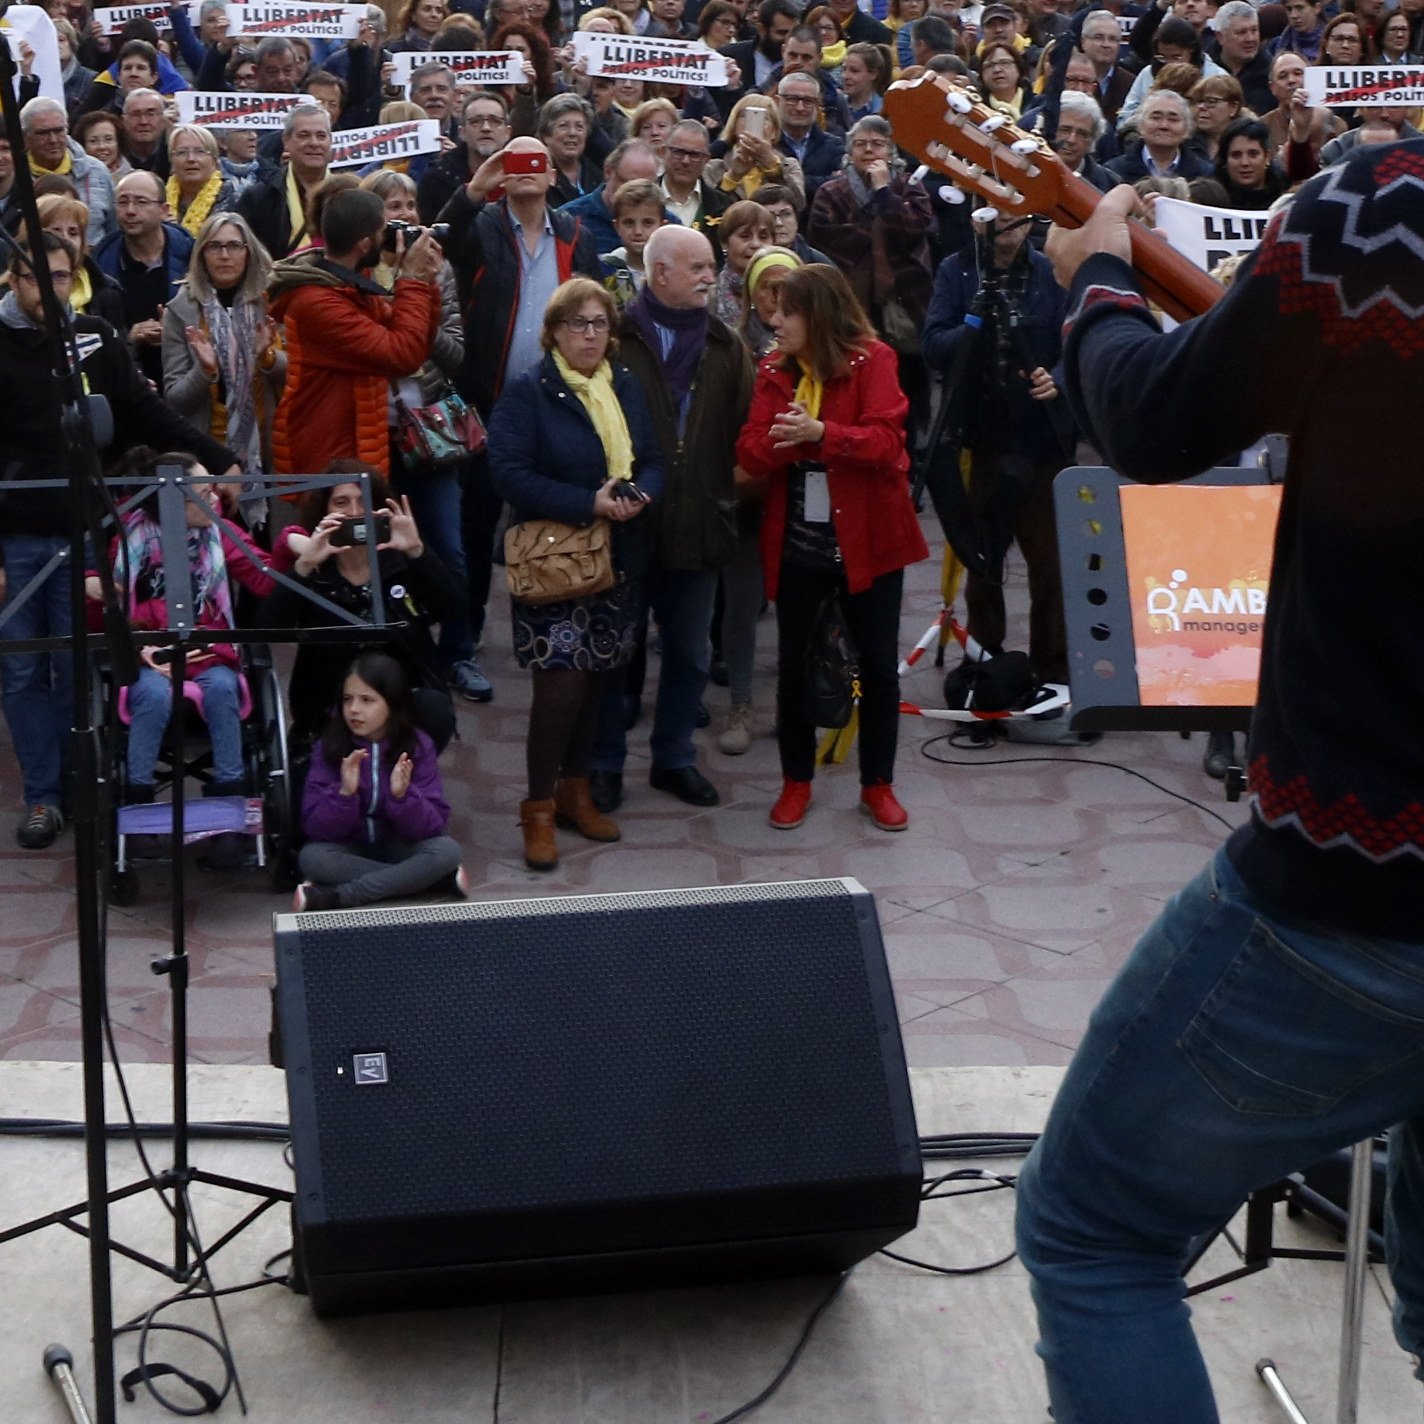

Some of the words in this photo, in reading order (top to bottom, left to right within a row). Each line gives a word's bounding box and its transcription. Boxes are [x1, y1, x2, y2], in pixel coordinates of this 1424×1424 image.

[243, 8, 344, 24] LLIBERTAT
[603, 45, 710, 70] LLIBERTAT
[1183, 619, 1260, 635] manage
[360, 1057, 381, 1079] EV
